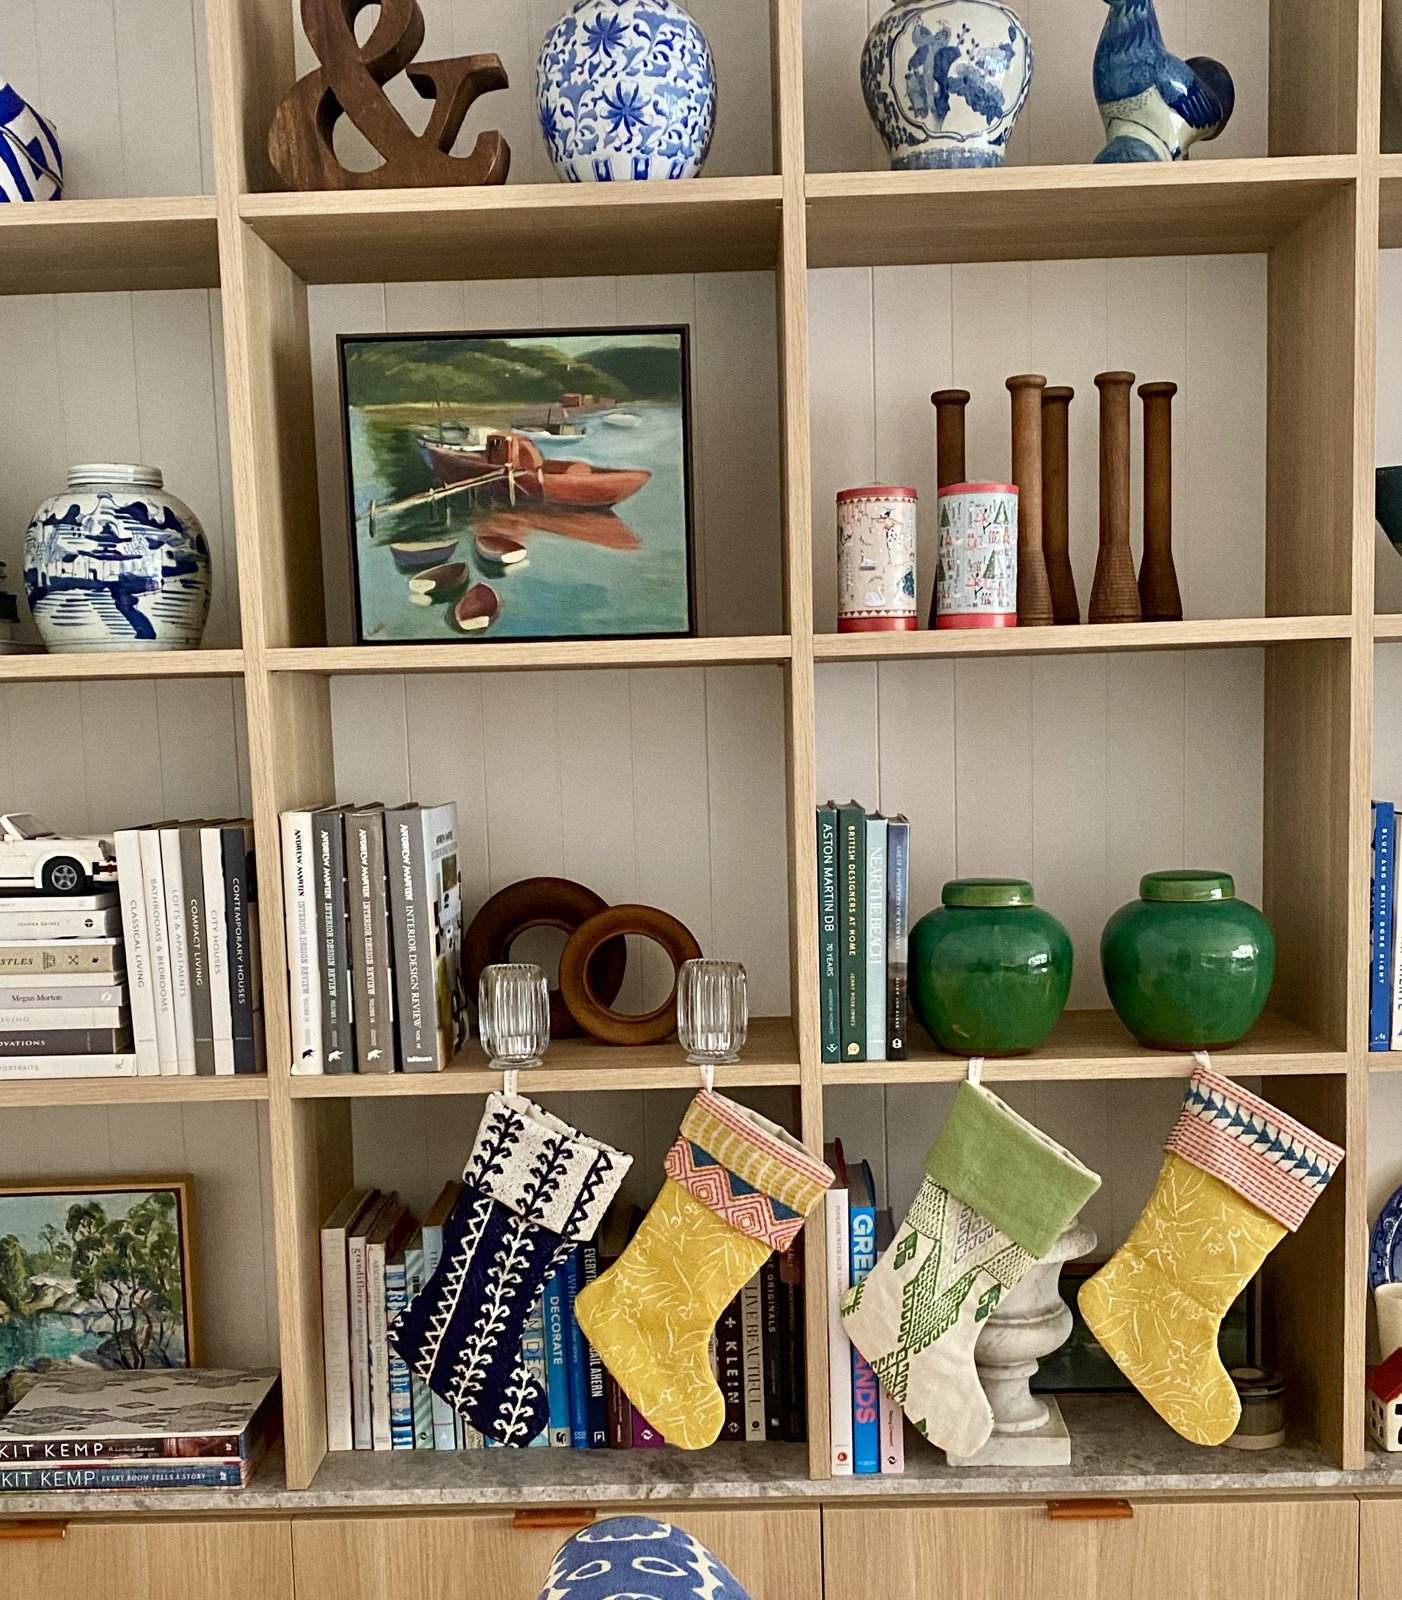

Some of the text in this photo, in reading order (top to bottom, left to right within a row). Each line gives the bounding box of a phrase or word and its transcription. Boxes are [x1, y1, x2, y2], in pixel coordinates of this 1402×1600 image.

[294, 829, 303, 864] ANDREW
[321, 830, 330, 866] ANDREW
[358, 829, 369, 866] ANDREW
[399, 824, 411, 865] ANDREW
[823, 824, 834, 864] ASTON
[296, 865, 304, 897] MARTIN
[322, 867, 332, 899] MARTIN
[361, 866, 370, 898] MARTIN
[402, 865, 413, 901] MARTIN
[823, 867, 834, 911] MARTIN
[848, 825, 856, 956] BRITISH DESIGNERS AT HOME
[297, 900, 307, 935] INTERIOR
[324, 902, 333, 937] INTERIOR
[362, 901, 372, 936] INTERIOR
[824, 915, 834, 931] DB
[869, 846, 883, 964] NEAR THE BEACH
[130, 900, 144, 988] CLASSICAL LIVING
[150, 879, 163, 942] BATHROOMS
[157, 955, 168, 1012] BEDROOMS
[172, 889, 180, 920] LOFTS
[176, 934, 186, 998] APARTMENTS
[190, 899, 203, 986] COMPACT LIVING
[210, 910, 221, 975] CITY HOUSES
[232, 877, 246, 1004] CONTEMPORARY HOUSES
[405, 906, 417, 953] INTERIOR
[826, 943, 834, 951] 70
[299, 937, 308, 963] DESIGN
[326, 938, 335, 966] DESIGN
[364, 937, 374, 965] DESIGN
[301, 966, 309, 994] REVIEW
[327, 968, 336, 997] REVIEW
[366, 966, 375, 995] REVIEW
[408, 954, 419, 990] DESIGN
[12, 994, 63, 1003] Megan Morton
[411, 992, 421, 1028] REVIEW
[351, 1247, 366, 1304] grandiflora
[767, 1274, 776, 1333] ORIGINALS
[853, 1213, 877, 1424] GREE ANDS
[550, 1295, 563, 1365] DECORATE
[745, 1286, 761, 1408] LIVE BEAUTIFUL
[375, 1345, 384, 1375] THINGS
[725, 1341, 740, 1404] KLEIN
[590, 1368, 603, 1397] AHERN
[0, 1444, 34, 1458] KIT
[44, 1443, 103, 1458] KEMP
[2, 1471, 33, 1487] KIT
[41, 1471, 96, 1487] KEMP
